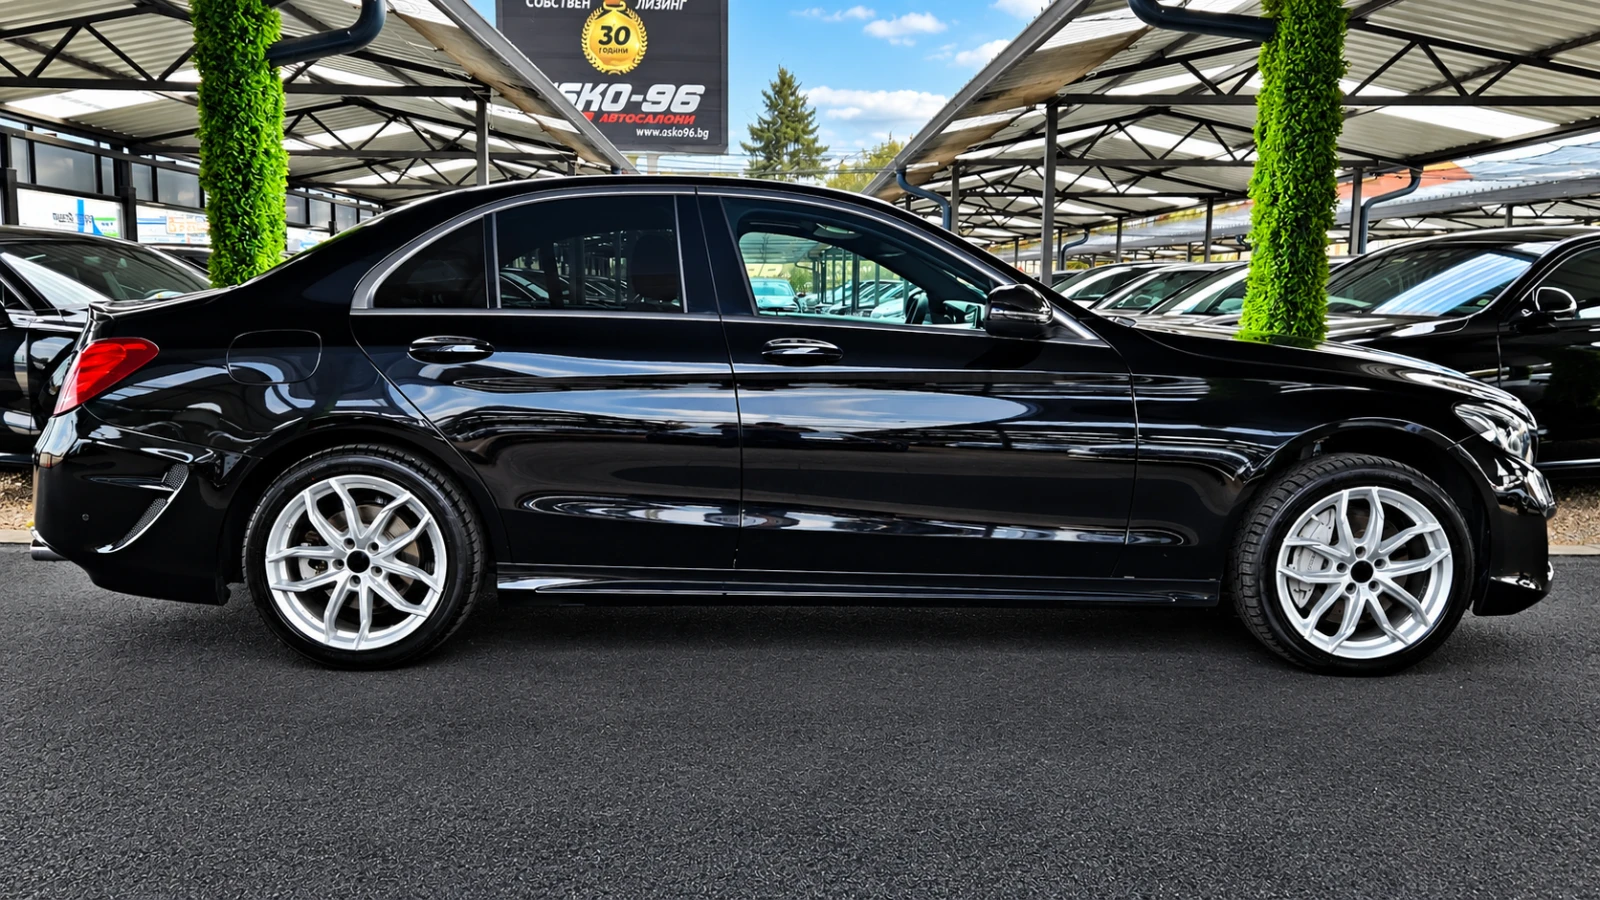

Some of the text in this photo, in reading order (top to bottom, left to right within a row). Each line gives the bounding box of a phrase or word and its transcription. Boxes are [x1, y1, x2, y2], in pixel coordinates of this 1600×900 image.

[526, 0, 687, 10] СОБСТВЕН ЛИЗИНГ
[598, 25, 631, 46] 30
[553, 83, 706, 113] SKO-96
[599, 113, 696, 125] АВТОСАЛОНИ
[636, 127, 710, 140] www.asko96.bg
